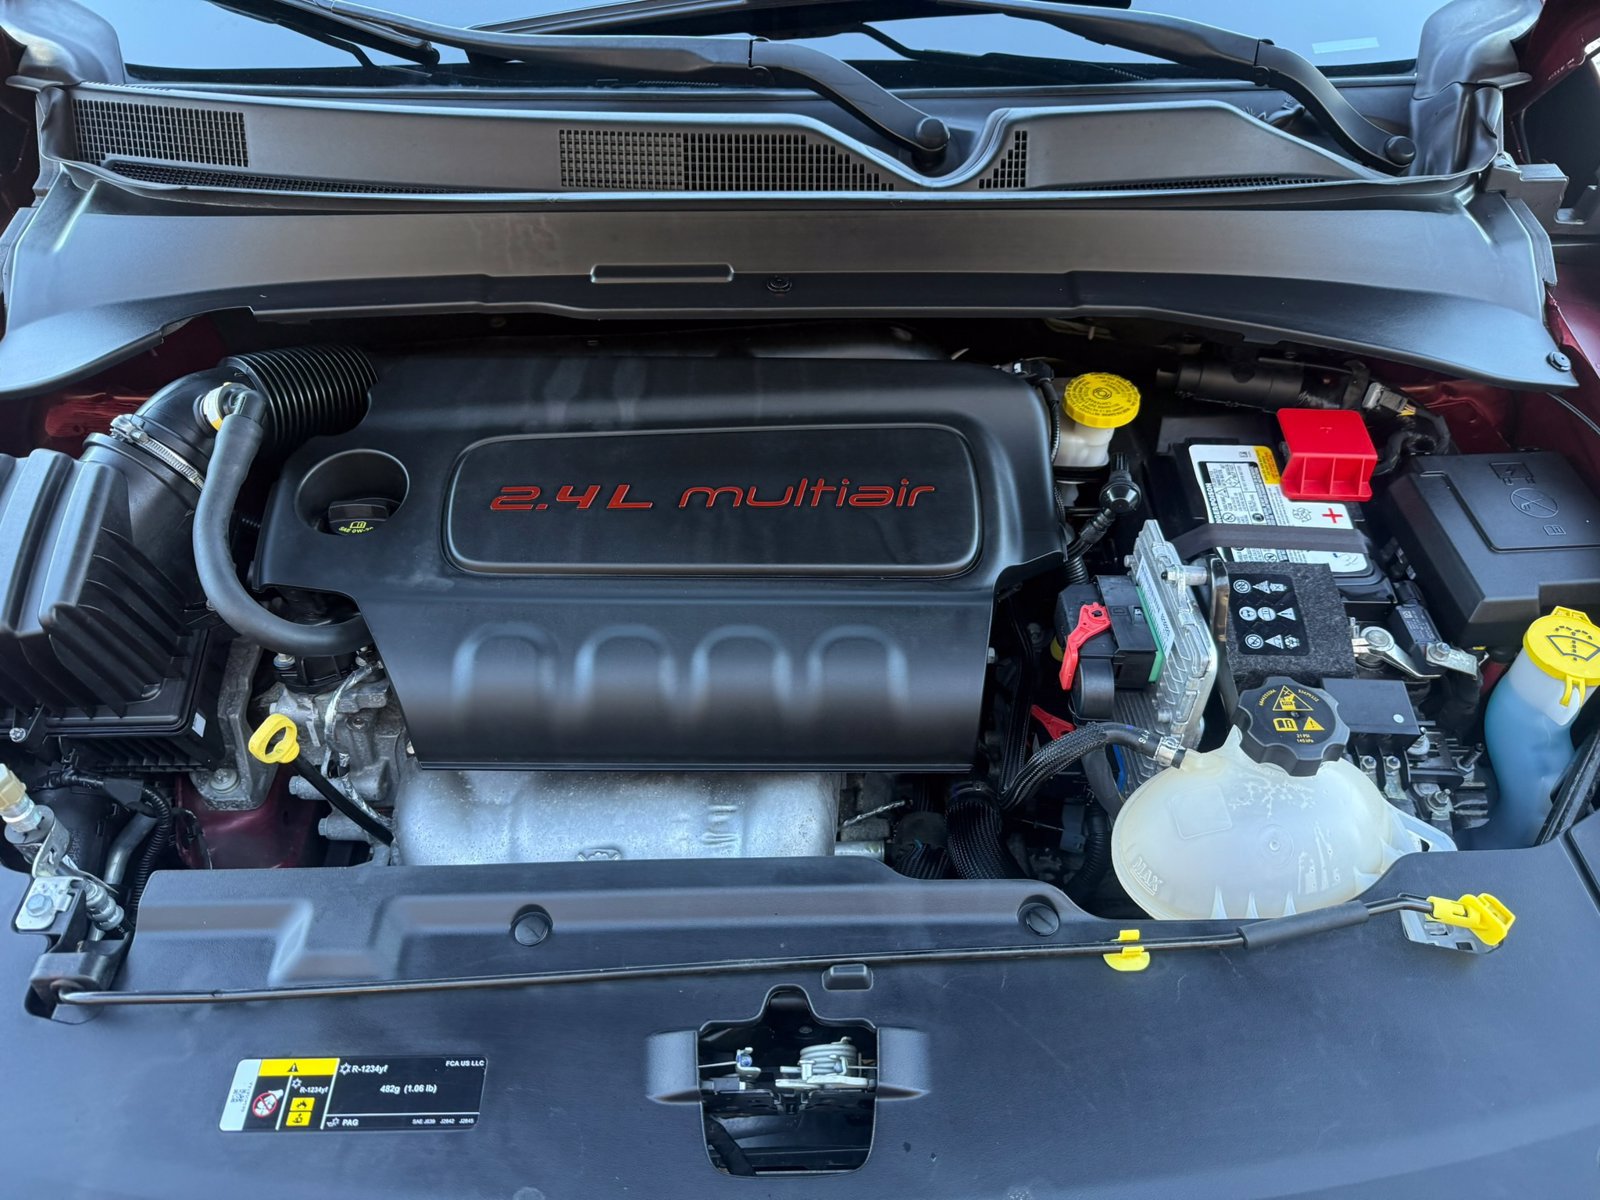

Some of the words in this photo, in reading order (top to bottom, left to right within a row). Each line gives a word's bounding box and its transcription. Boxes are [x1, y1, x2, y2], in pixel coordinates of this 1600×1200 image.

[678, 478, 935, 508] multiair
[351, 1064, 389, 1075] R-1234yf
[299, 1086, 329, 1095] R-1234yf
[379, 1084, 401, 1095] 482g
[425, 1084, 438, 1094] lb)
[341, 1119, 359, 1127] PAG
